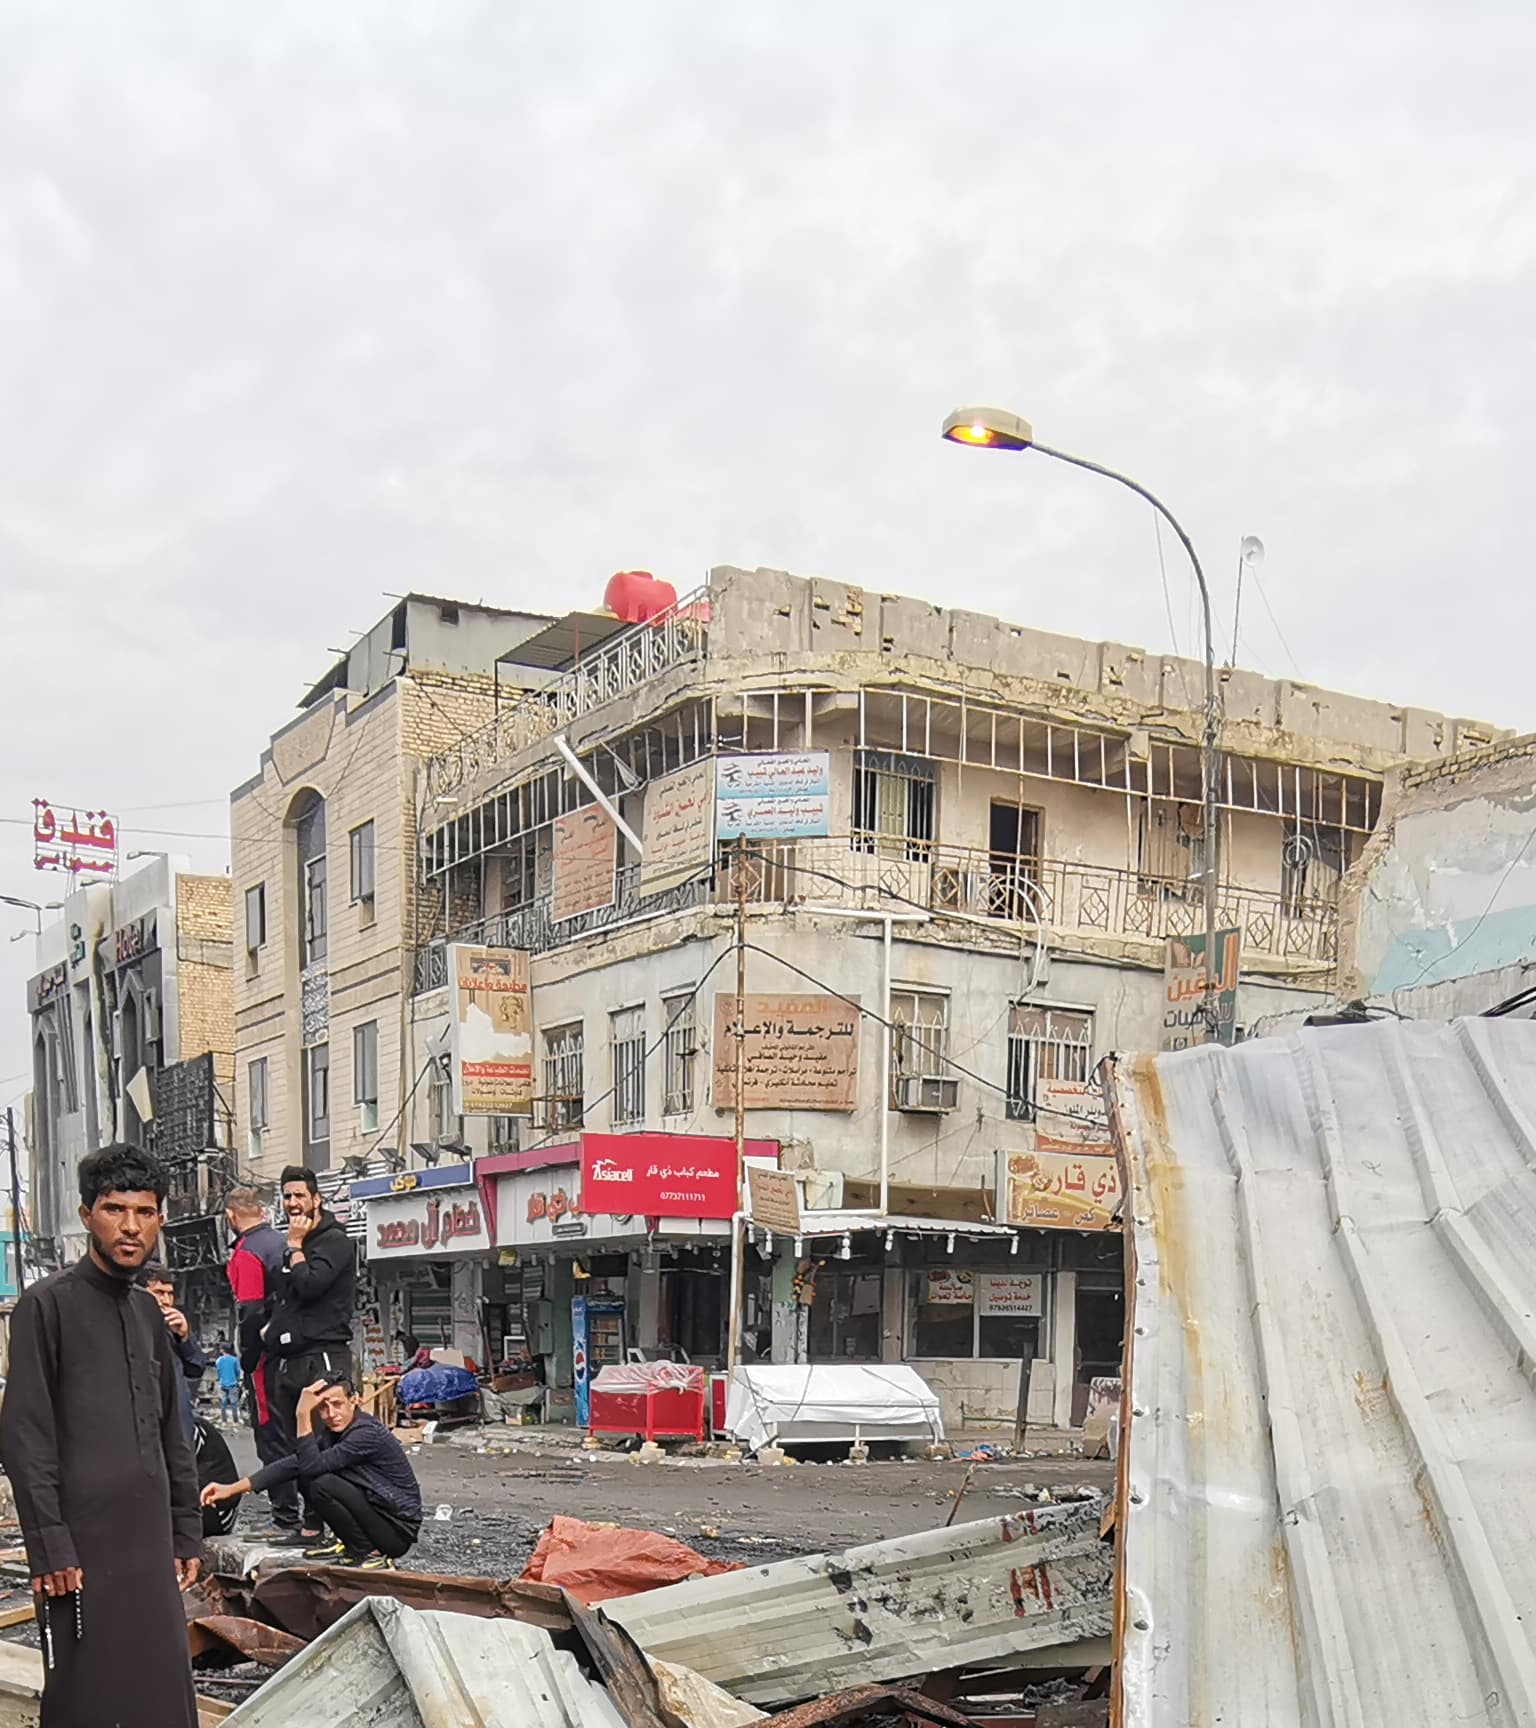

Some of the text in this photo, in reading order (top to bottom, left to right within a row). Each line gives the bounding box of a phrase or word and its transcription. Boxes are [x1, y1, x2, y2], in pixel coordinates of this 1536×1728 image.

[30, 796, 116, 851] فندق
[786, 1020, 854, 1041] للترجمة
[591, 1160, 634, 1183] Asiacell
[645, 1164, 721, 1180] مطعم كباب ذي قار
[1052, 1162, 1117, 1204] ذي قار
[1022, 1203, 1060, 1222] عصائر
[376, 1218, 421, 1249] محمد
